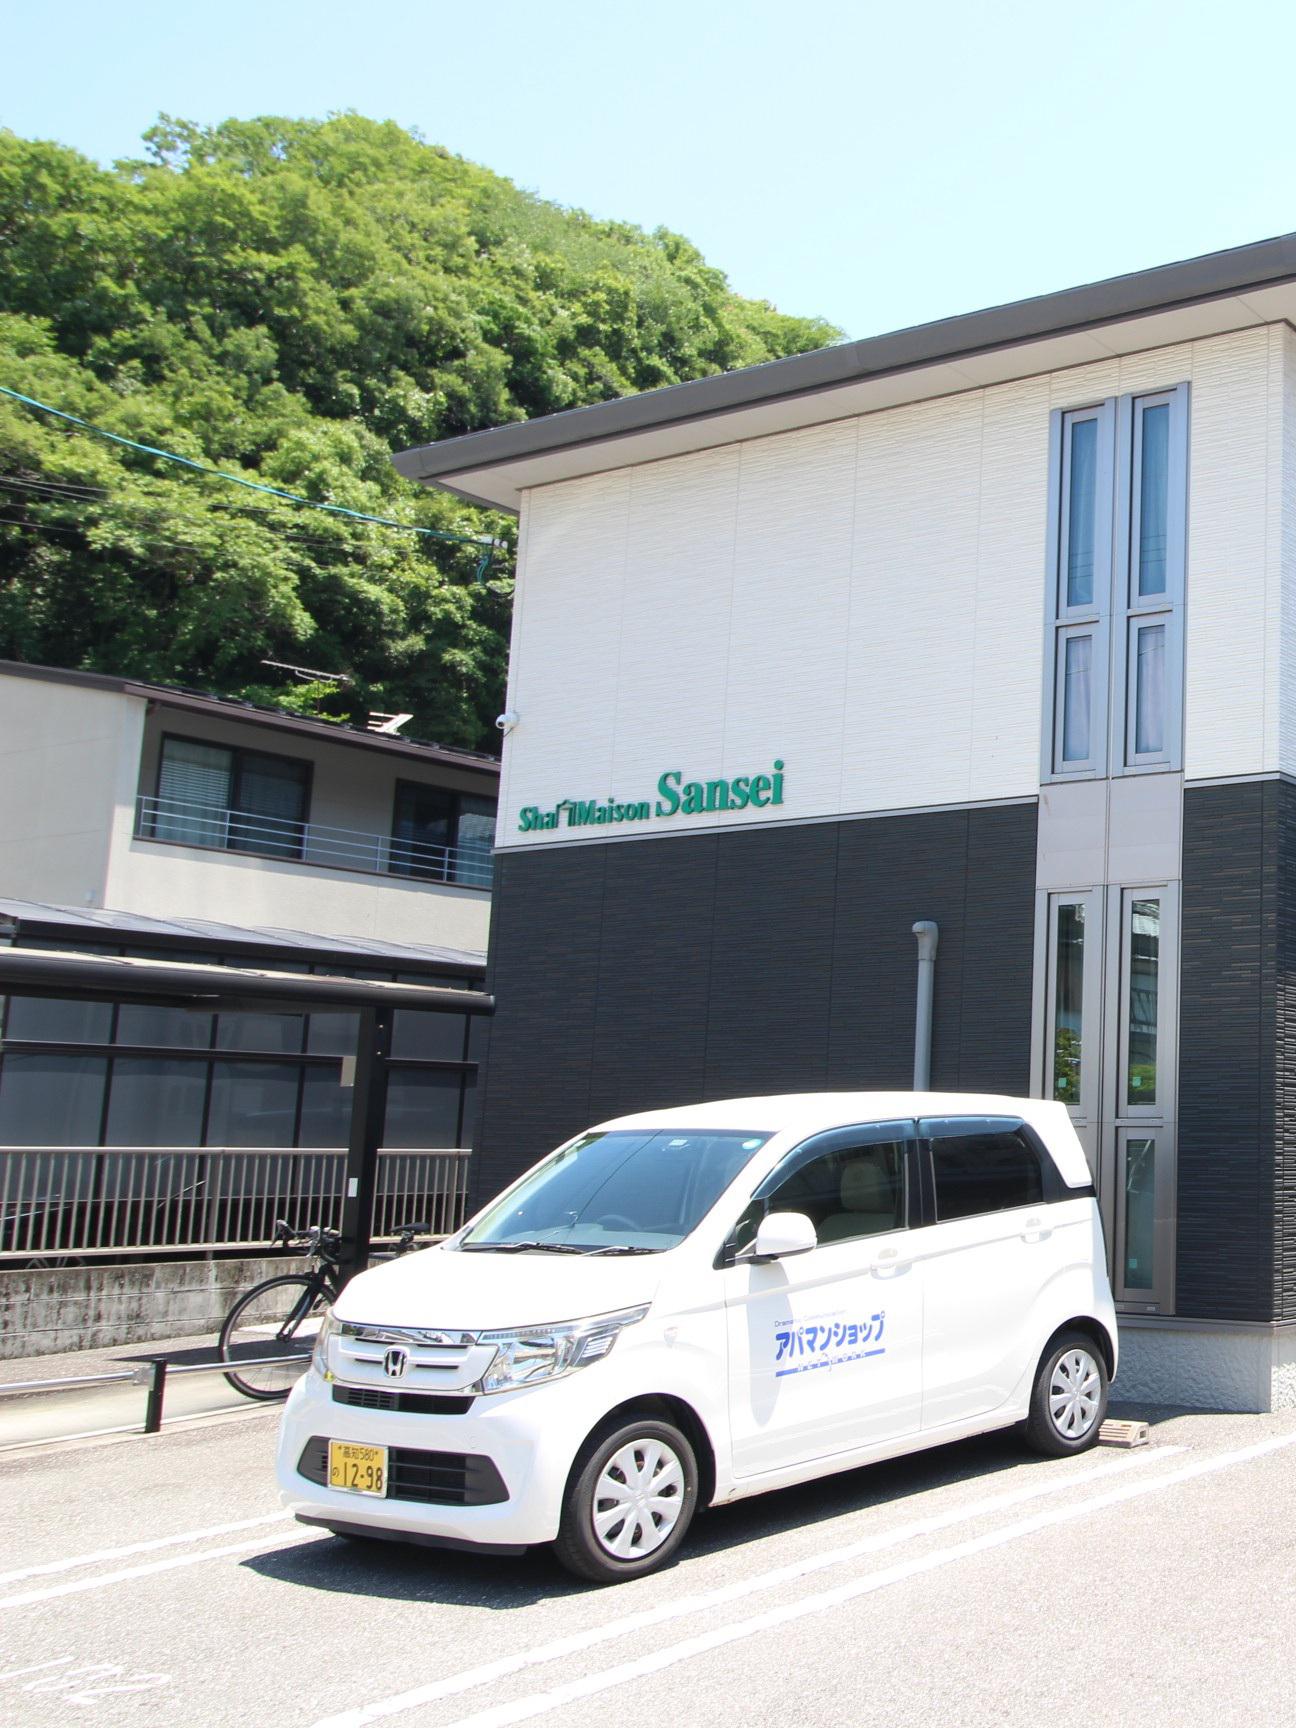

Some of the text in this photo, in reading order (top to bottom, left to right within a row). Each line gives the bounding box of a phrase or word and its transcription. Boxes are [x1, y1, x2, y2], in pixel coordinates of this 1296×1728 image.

[655, 759, 785, 817] Sansei
[775, 1310, 886, 1361] アパマンショップ
